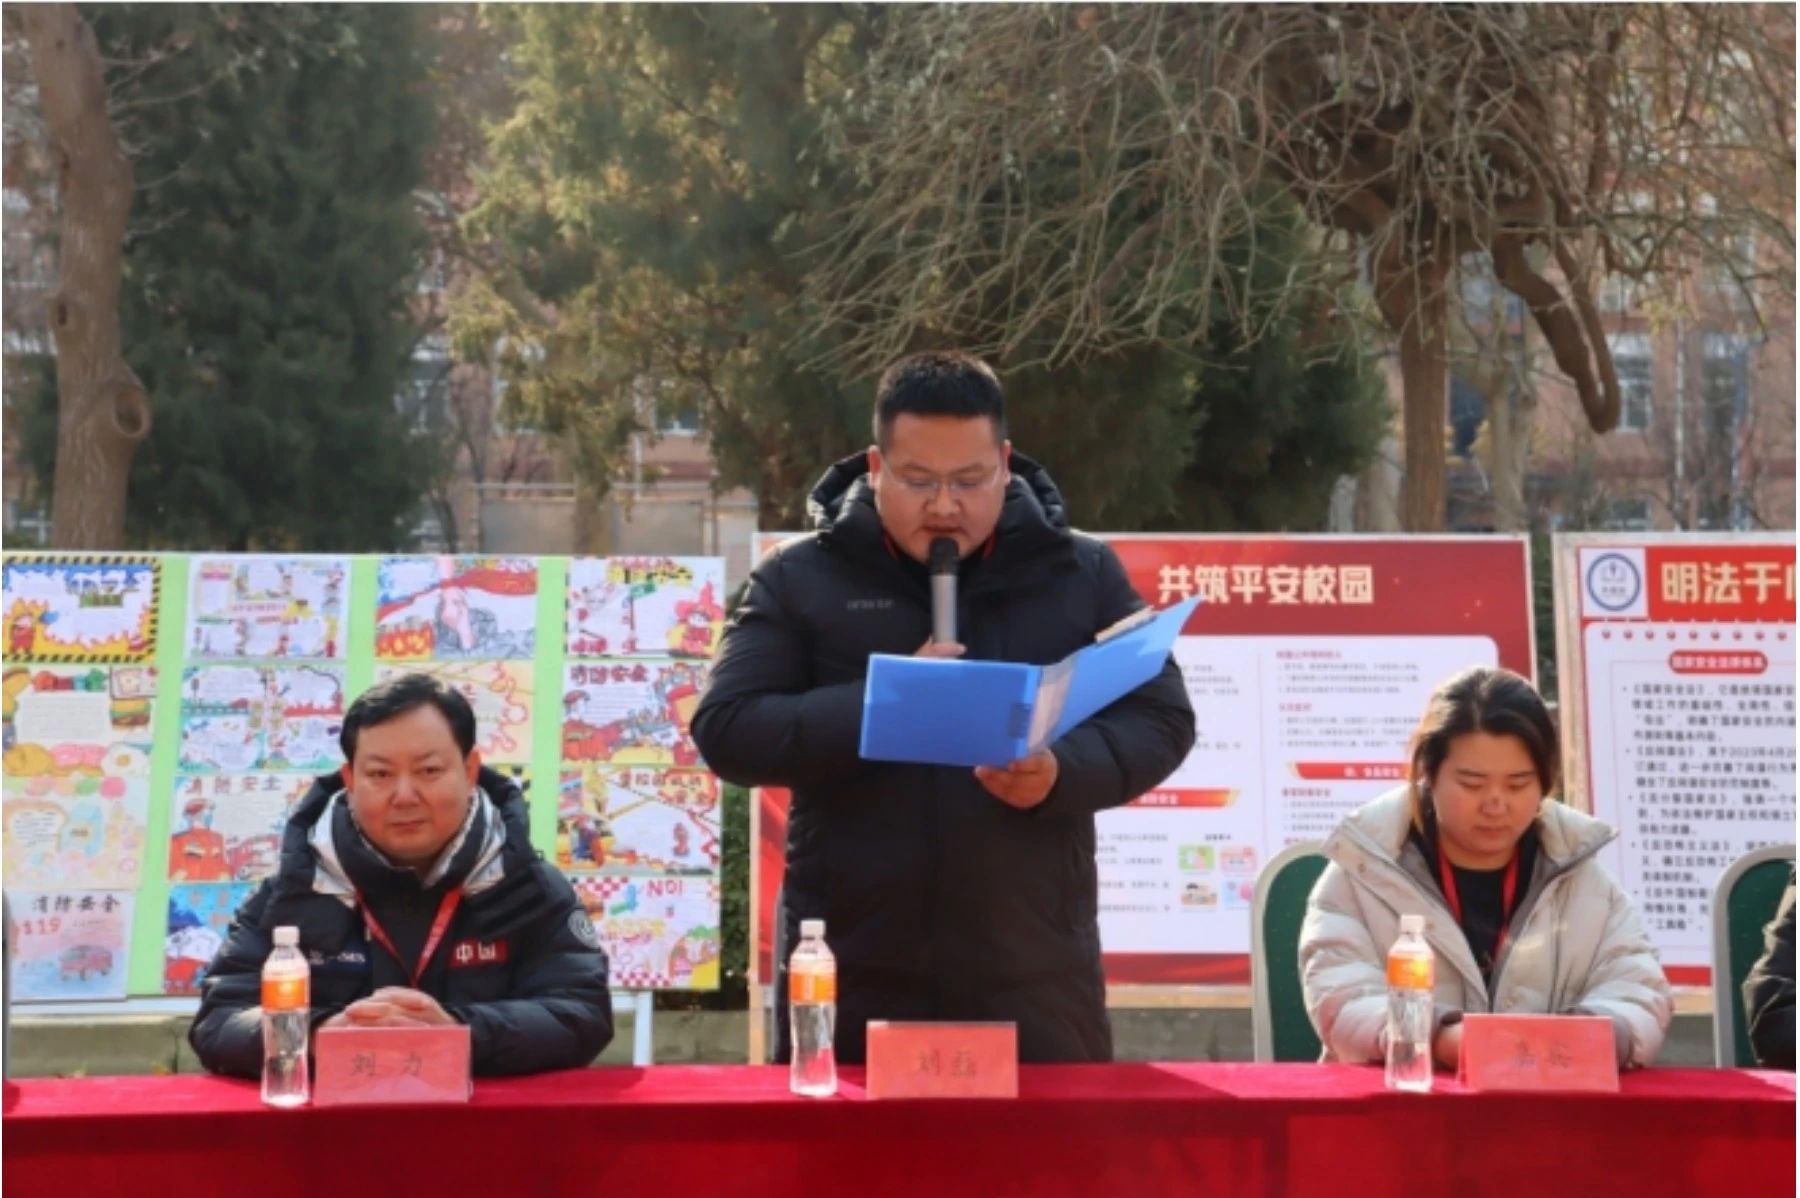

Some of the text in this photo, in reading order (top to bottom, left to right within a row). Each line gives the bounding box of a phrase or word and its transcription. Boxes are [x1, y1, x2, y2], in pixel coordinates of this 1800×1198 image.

[1158, 564, 1374, 604] 共筑平安校园
[1661, 562, 1796, 604] 明法于
